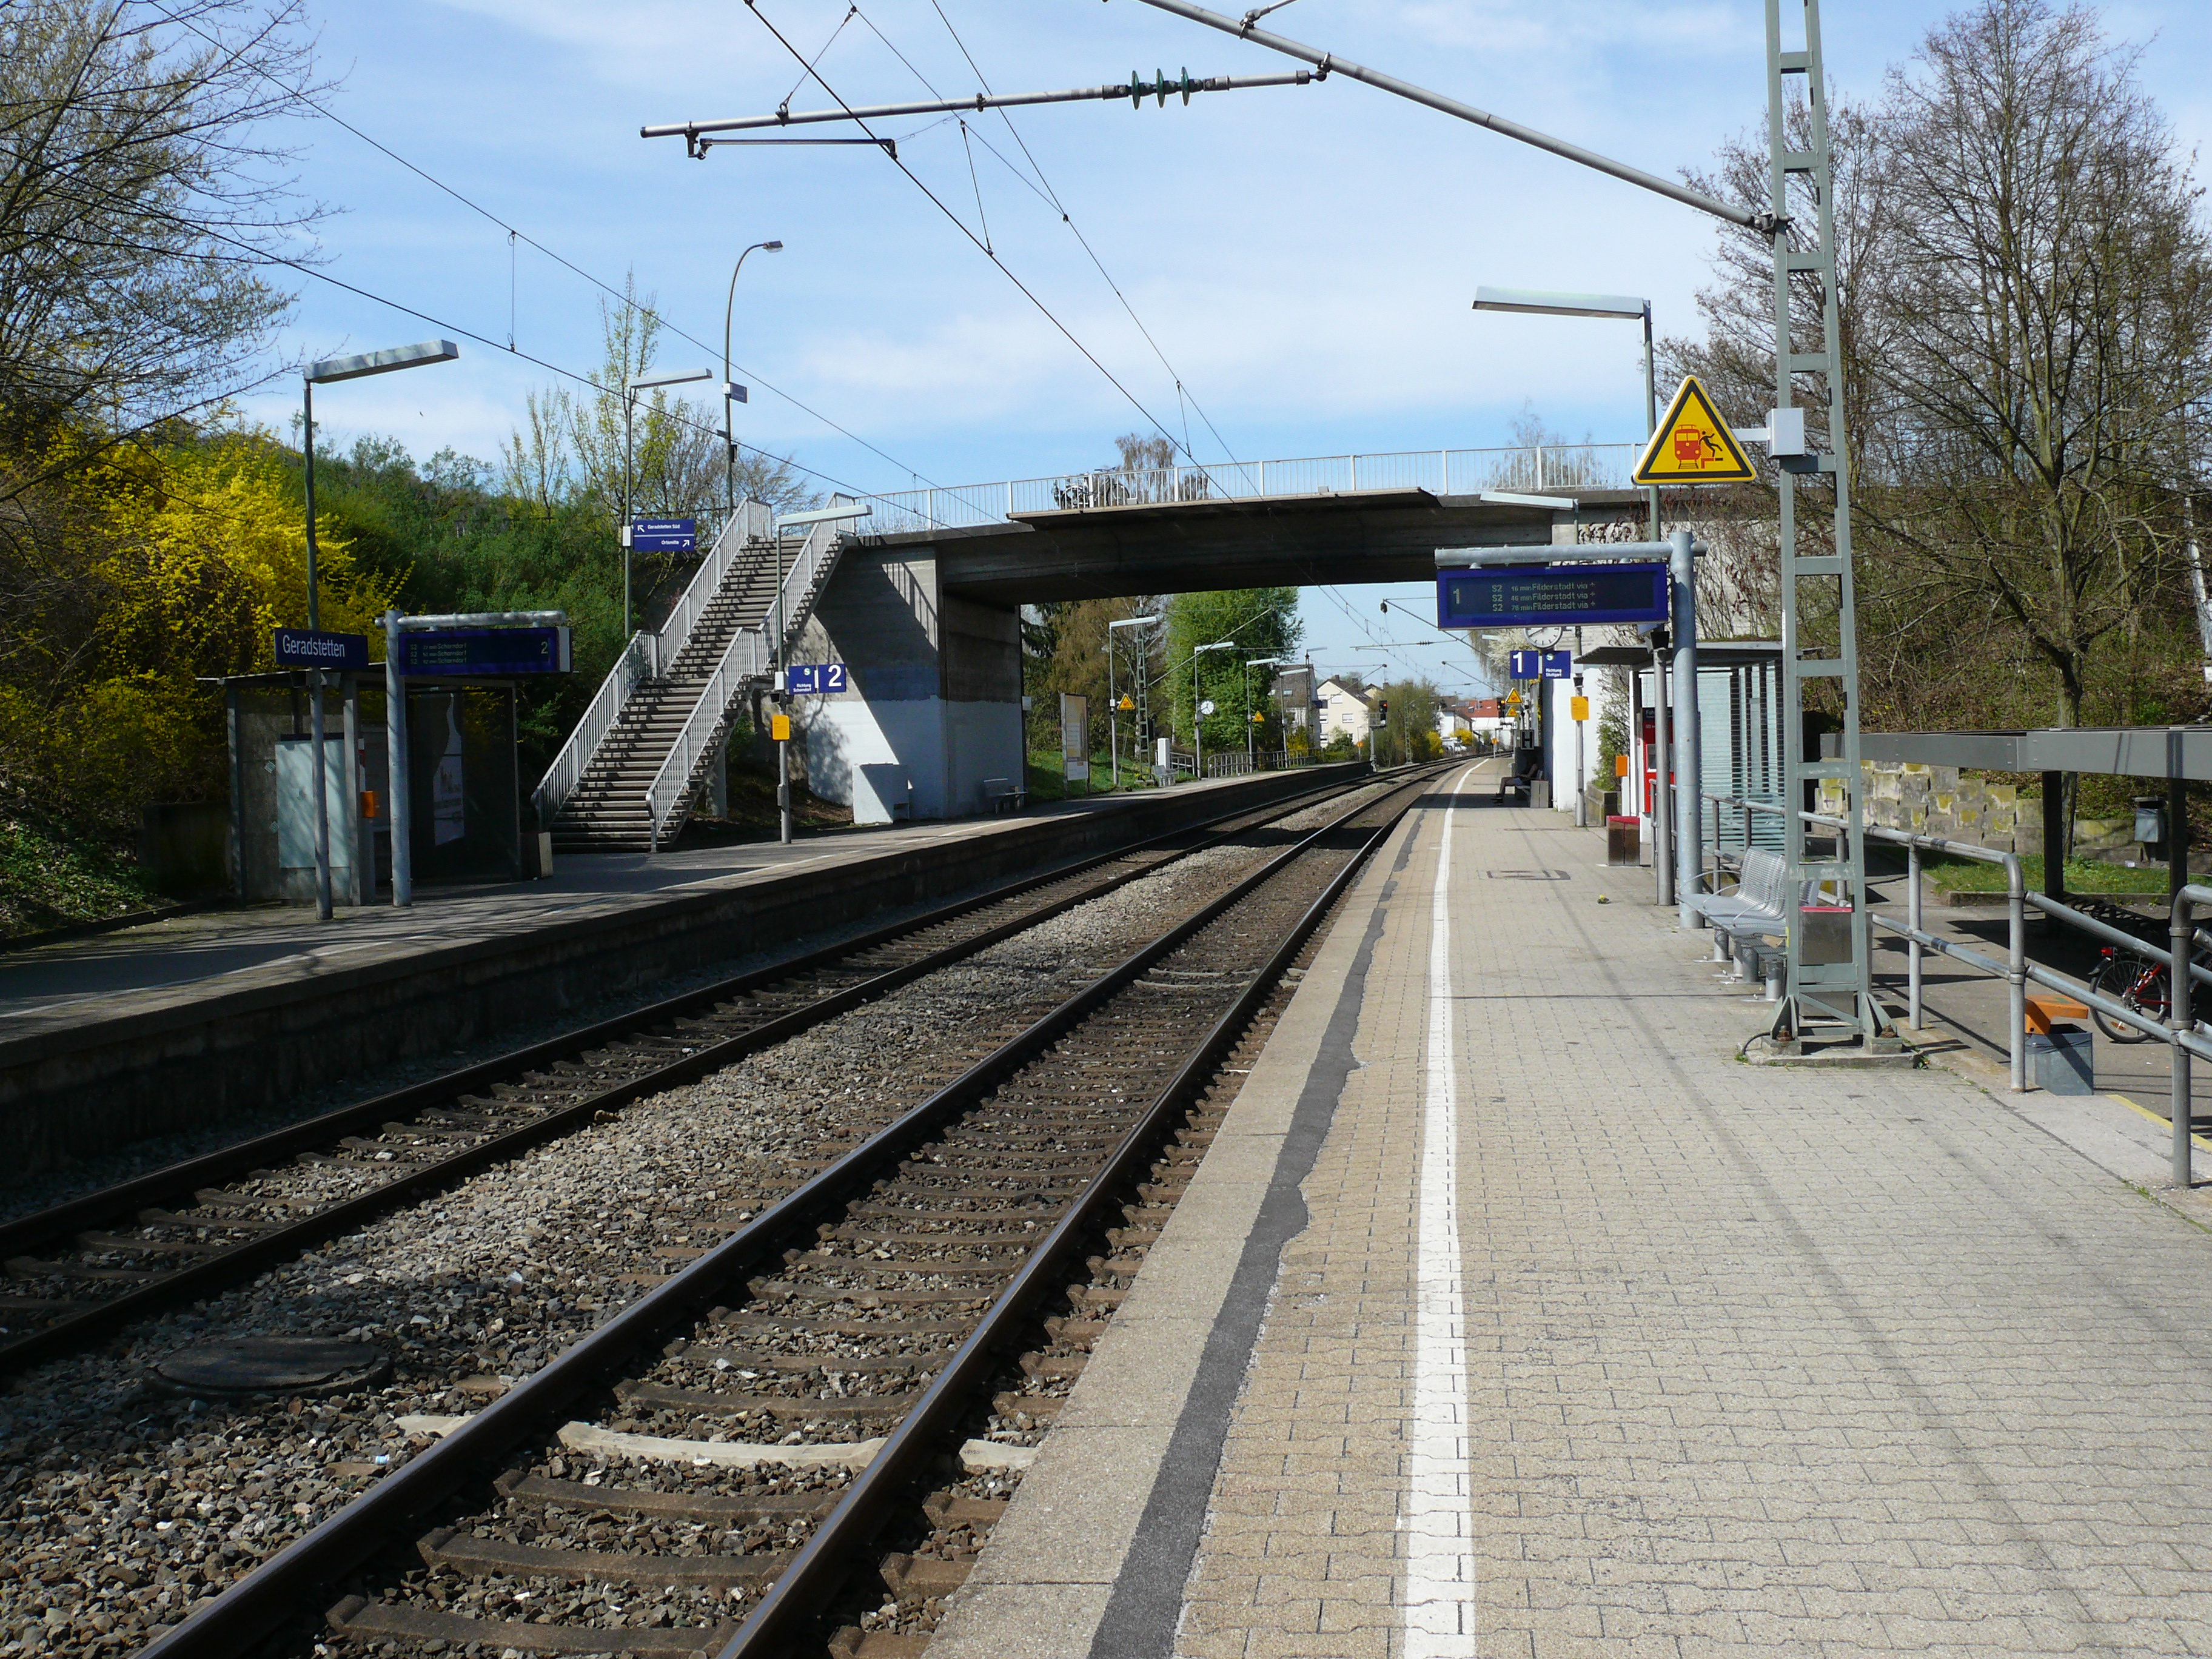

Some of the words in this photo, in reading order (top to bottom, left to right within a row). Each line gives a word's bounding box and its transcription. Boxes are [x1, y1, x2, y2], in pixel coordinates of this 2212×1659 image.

[1453, 588, 1460, 605] 1
[1532, 592, 1575, 601] Filderstadt
[1492, 603, 1503, 612] S2
[1533, 602, 1575, 610] Filderstadt
[282, 634, 345, 657] Geradstetten
[541, 641, 548, 654] 2
[1513, 652, 1523, 673] 1
[828, 665, 842, 687] 2
[1522, 731, 1533, 748] H
